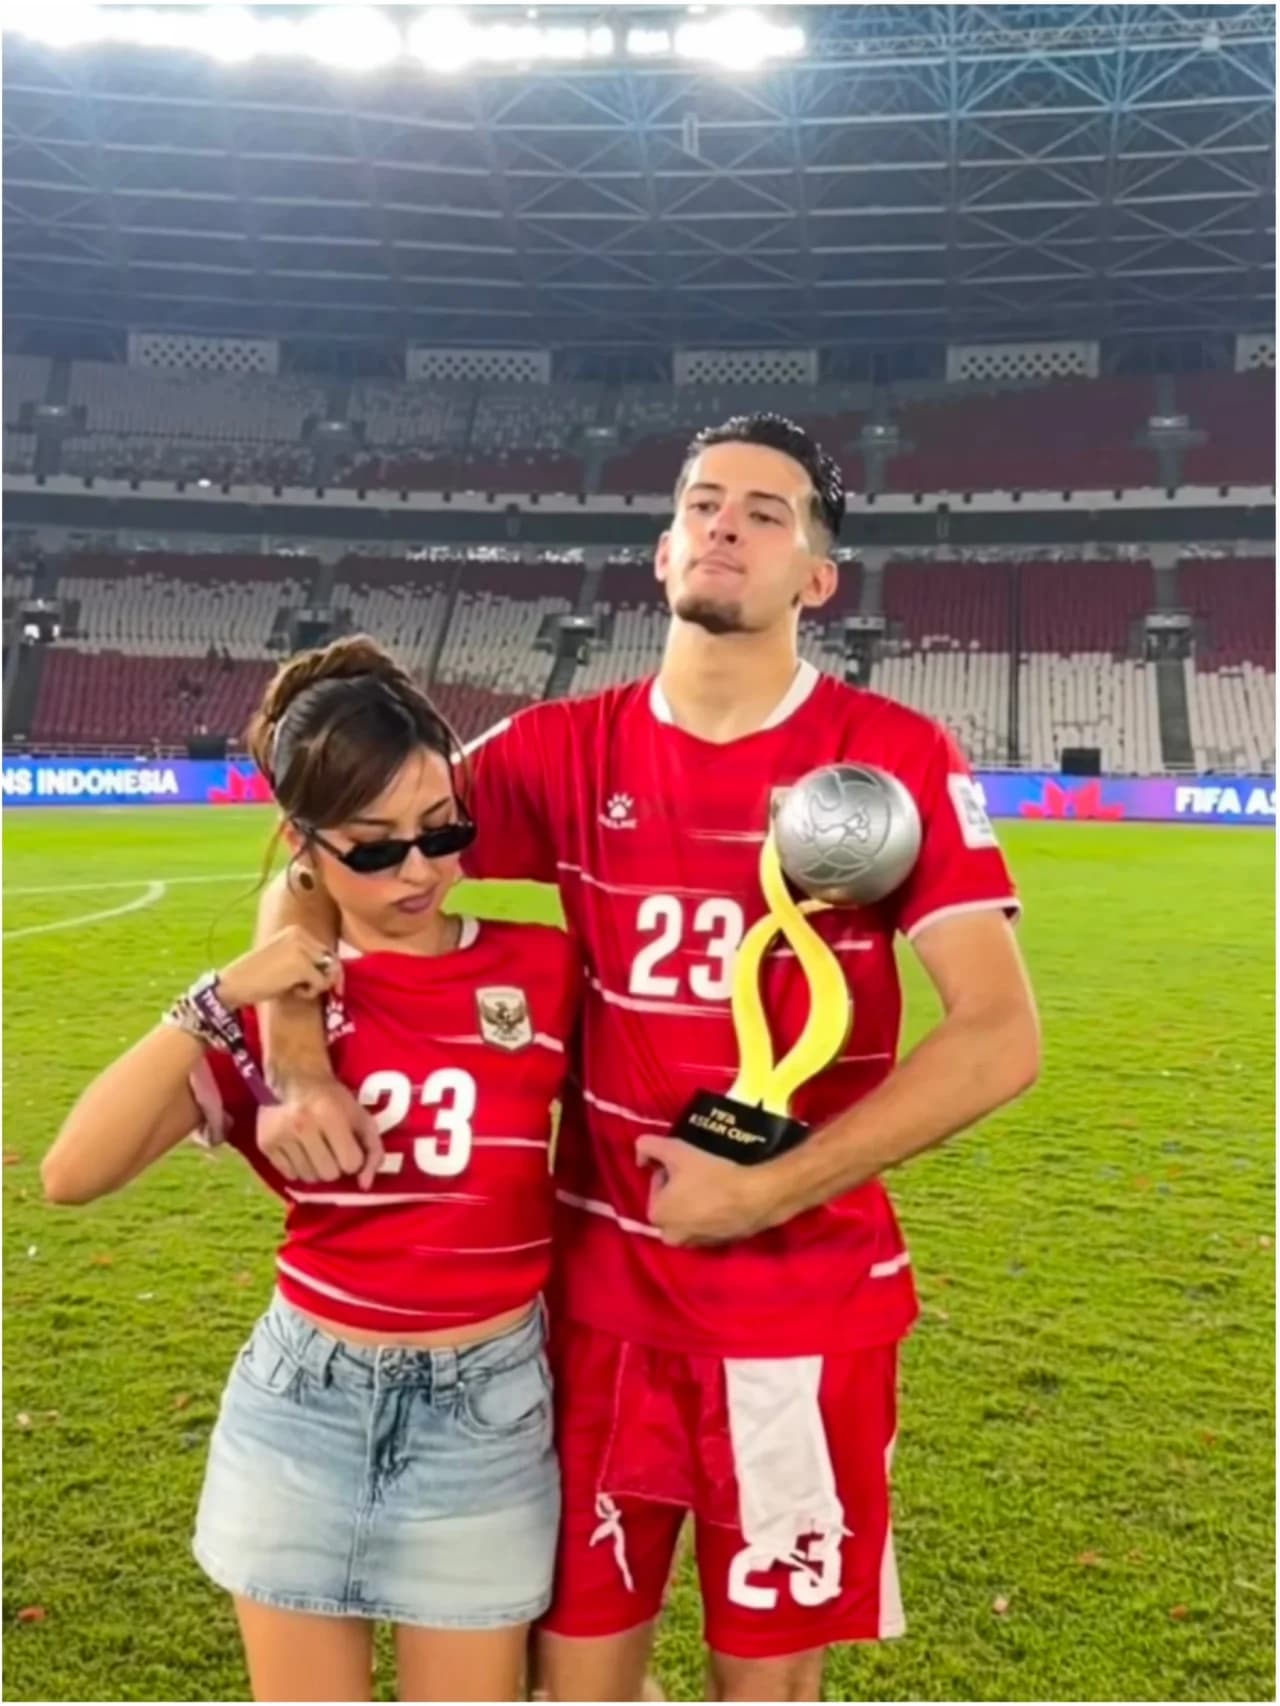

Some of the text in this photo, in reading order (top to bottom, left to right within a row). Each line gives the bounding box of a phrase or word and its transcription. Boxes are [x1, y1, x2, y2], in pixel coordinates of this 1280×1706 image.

[36, 767, 179, 795] INDONESIA
[1175, 786, 1241, 814] FIFA
[628, 893, 744, 1001] 23
[358, 1067, 477, 1177] 23
